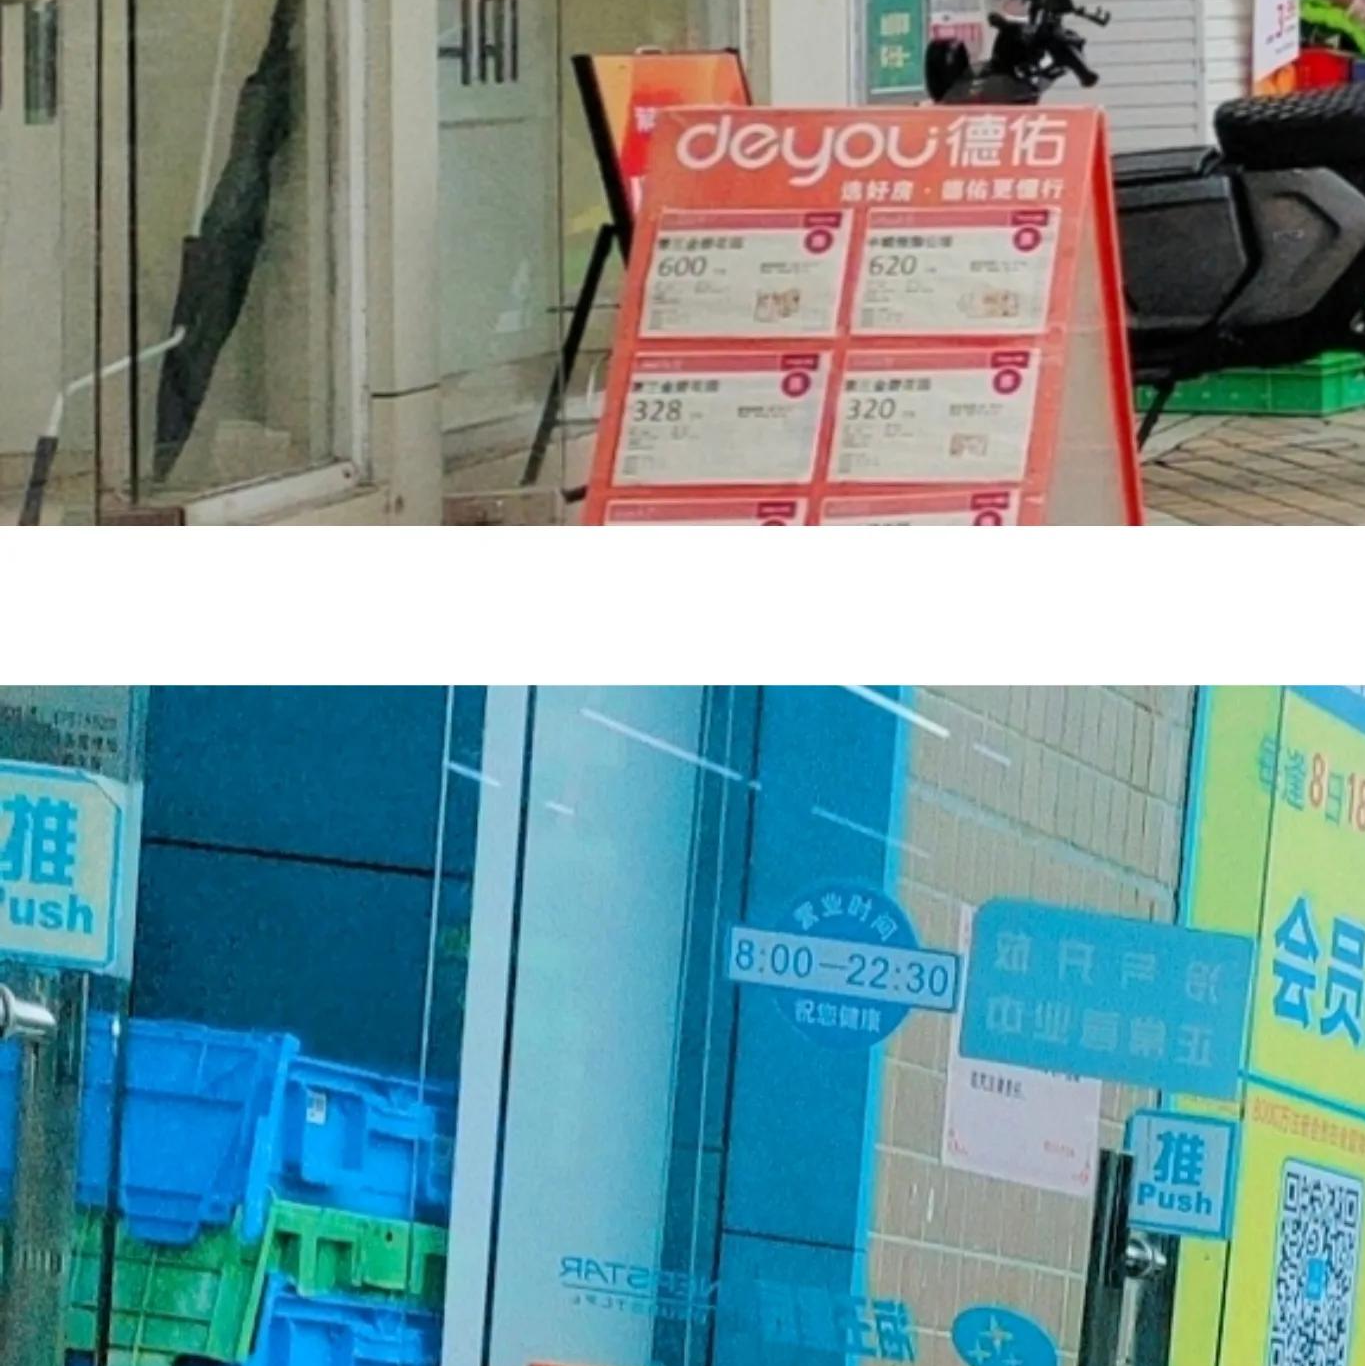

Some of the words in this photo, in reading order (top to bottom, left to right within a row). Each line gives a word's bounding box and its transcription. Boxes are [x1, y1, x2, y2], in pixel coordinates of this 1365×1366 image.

[676, 114, 938, 186] deyou
[946, 113, 1068, 167] 德佑
[657, 256, 708, 277] 600
[868, 254, 918, 276] 620
[632, 400, 683, 422] 328
[847, 399, 897, 420] 320
[0, 889, 93, 935] ush
[793, 891, 899, 943] 营业时间
[793, 998, 883, 1033] 祝您健康
[1152, 1131, 1206, 1187] 推
[1137, 1184, 1213, 1217] Push
